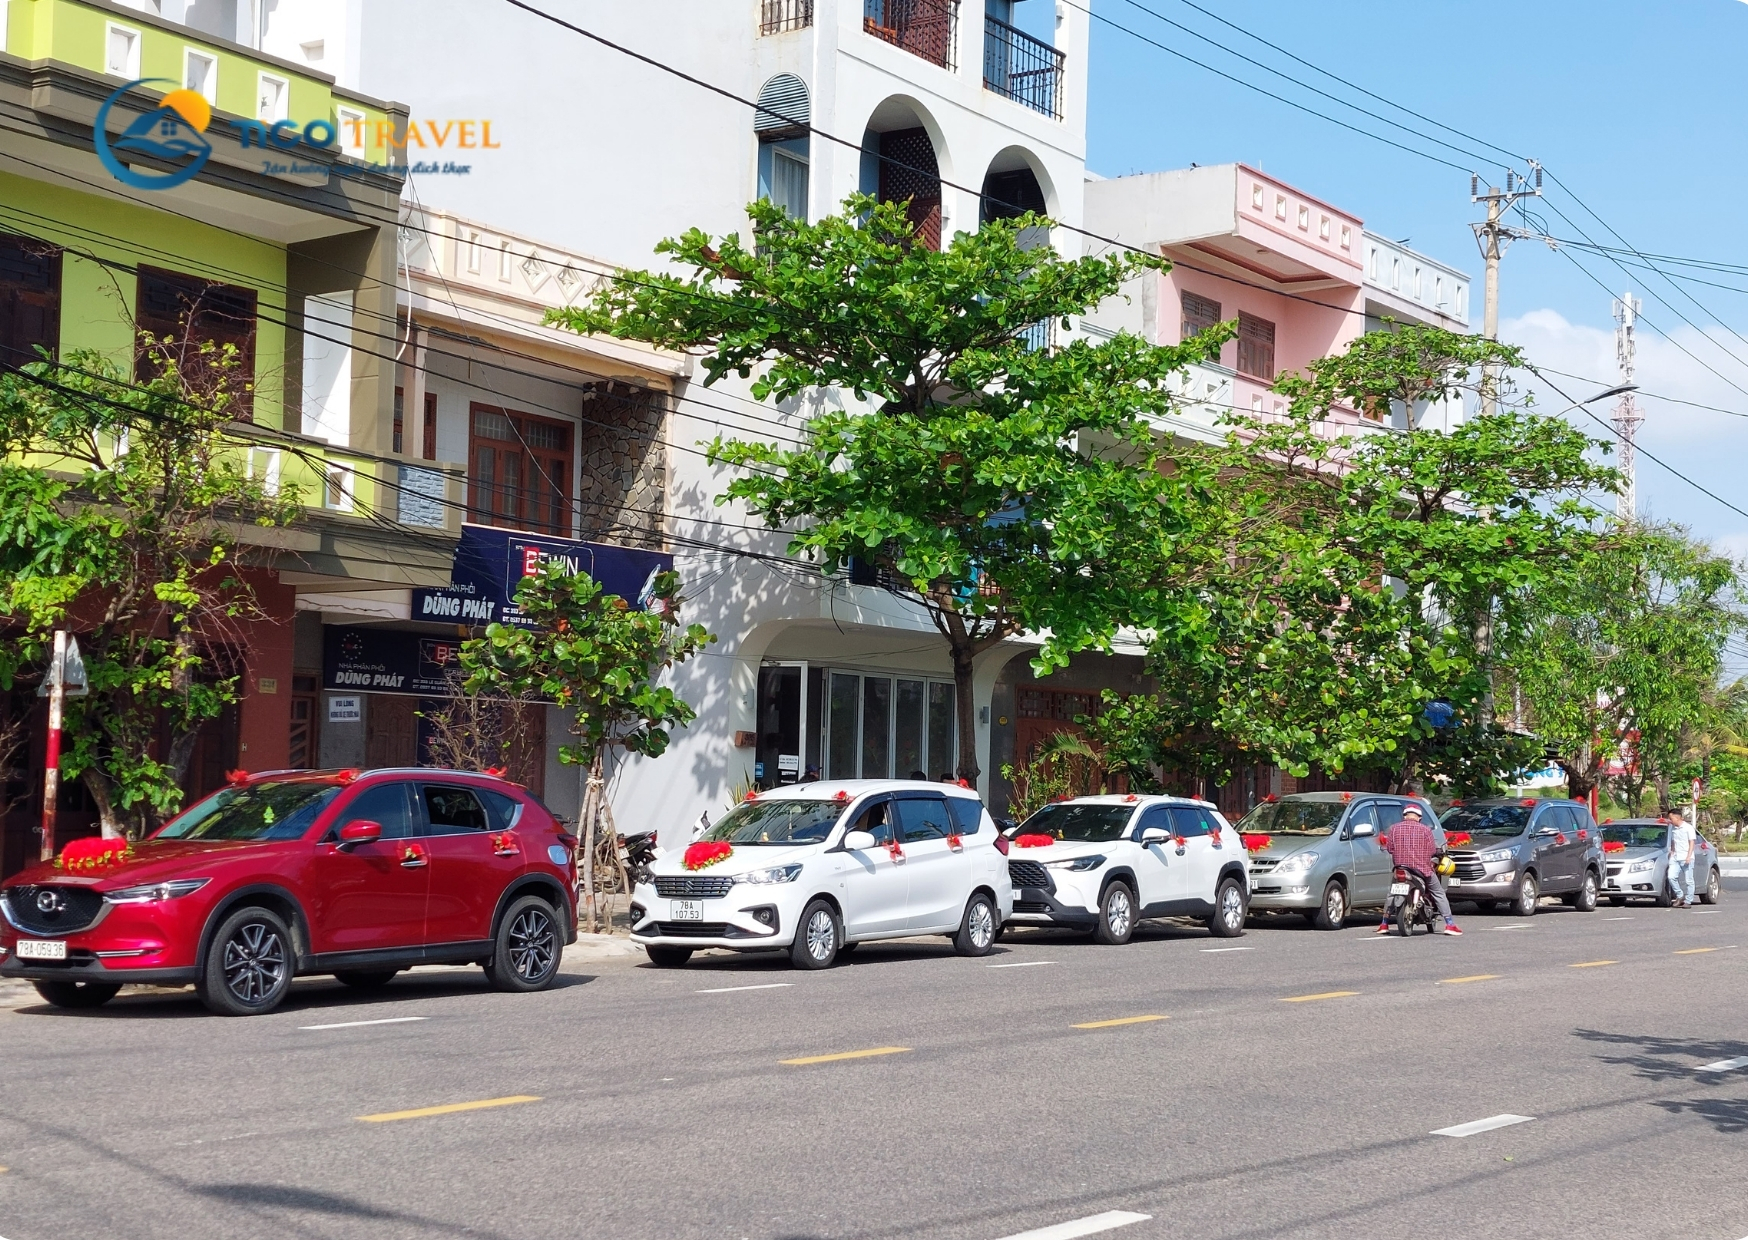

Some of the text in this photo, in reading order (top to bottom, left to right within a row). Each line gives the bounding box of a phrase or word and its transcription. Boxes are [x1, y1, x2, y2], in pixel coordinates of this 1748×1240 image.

[422, 592, 496, 620] DŨNG PHÁT
[335, 669, 405, 688] DŨNG PHÁT
